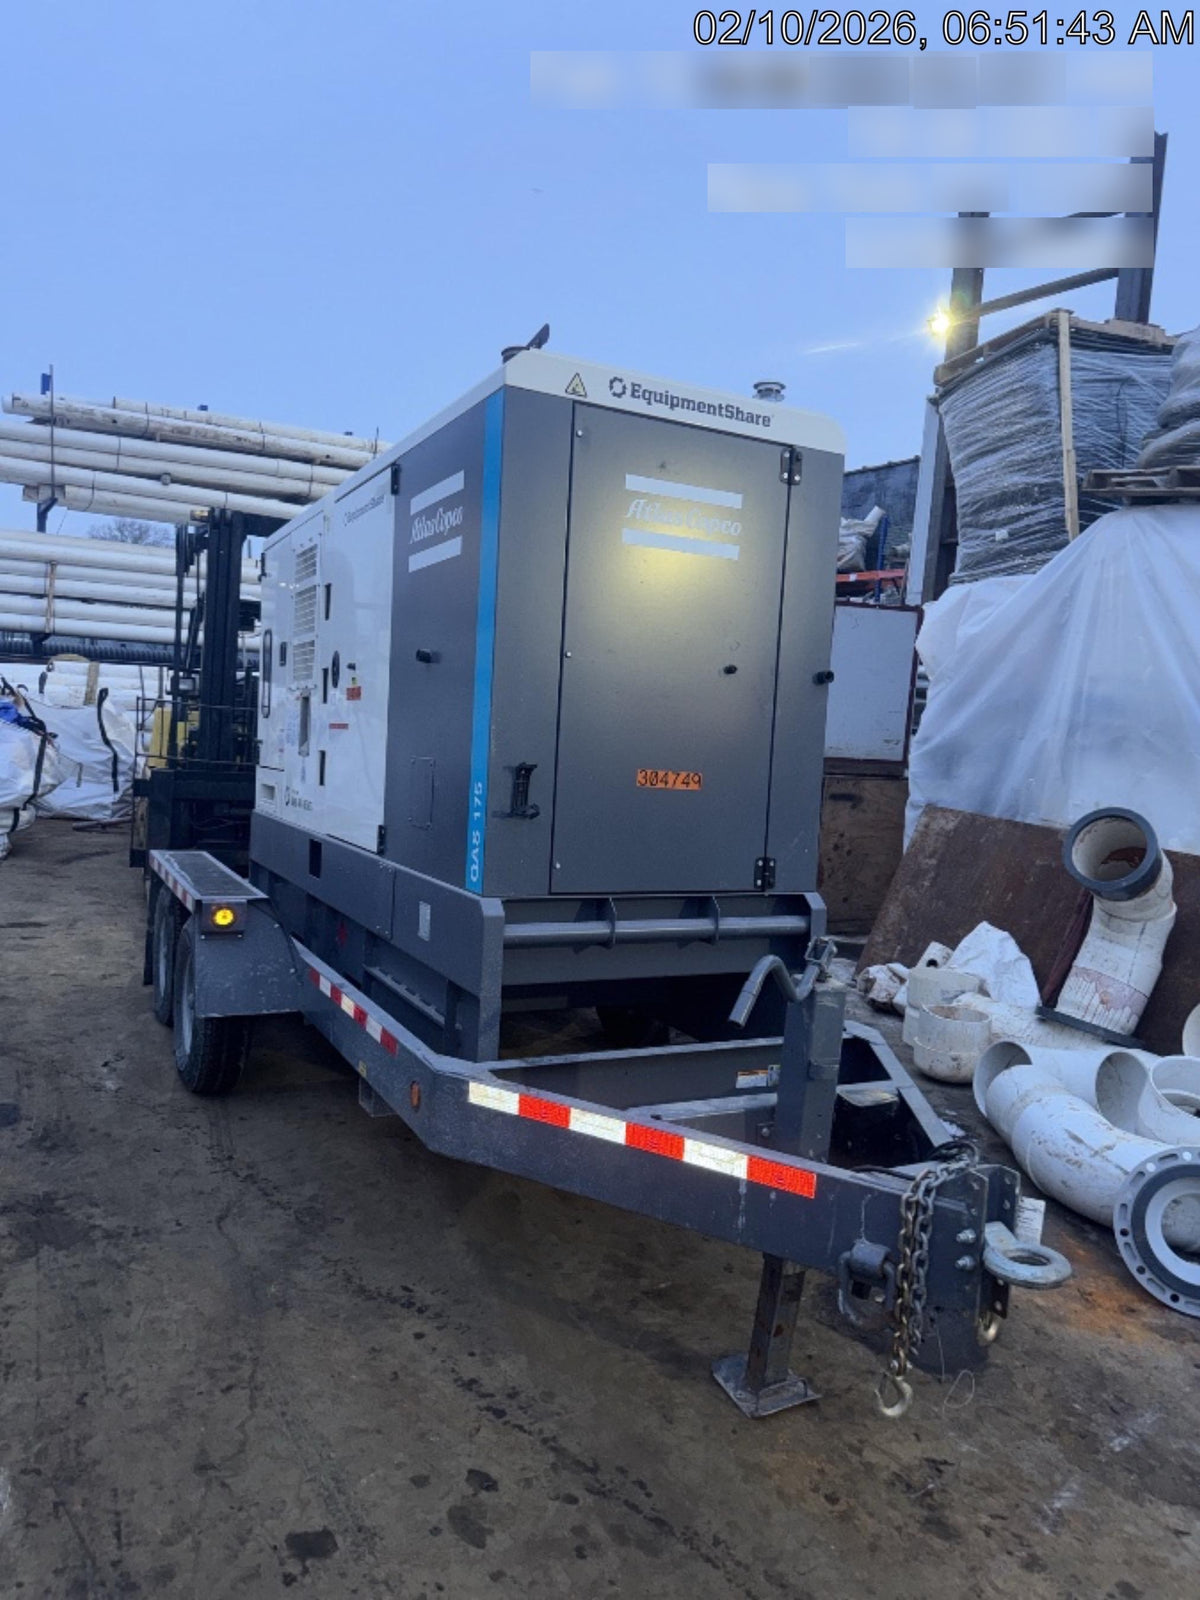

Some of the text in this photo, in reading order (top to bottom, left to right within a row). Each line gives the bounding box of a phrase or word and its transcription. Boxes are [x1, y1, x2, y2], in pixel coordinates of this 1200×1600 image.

[631, 381, 772, 428] EquipmentShare
[626, 499, 742, 536] Atlas Copco
[637, 769, 702, 789] 304749
[470, 781, 483, 882] QAS 175
